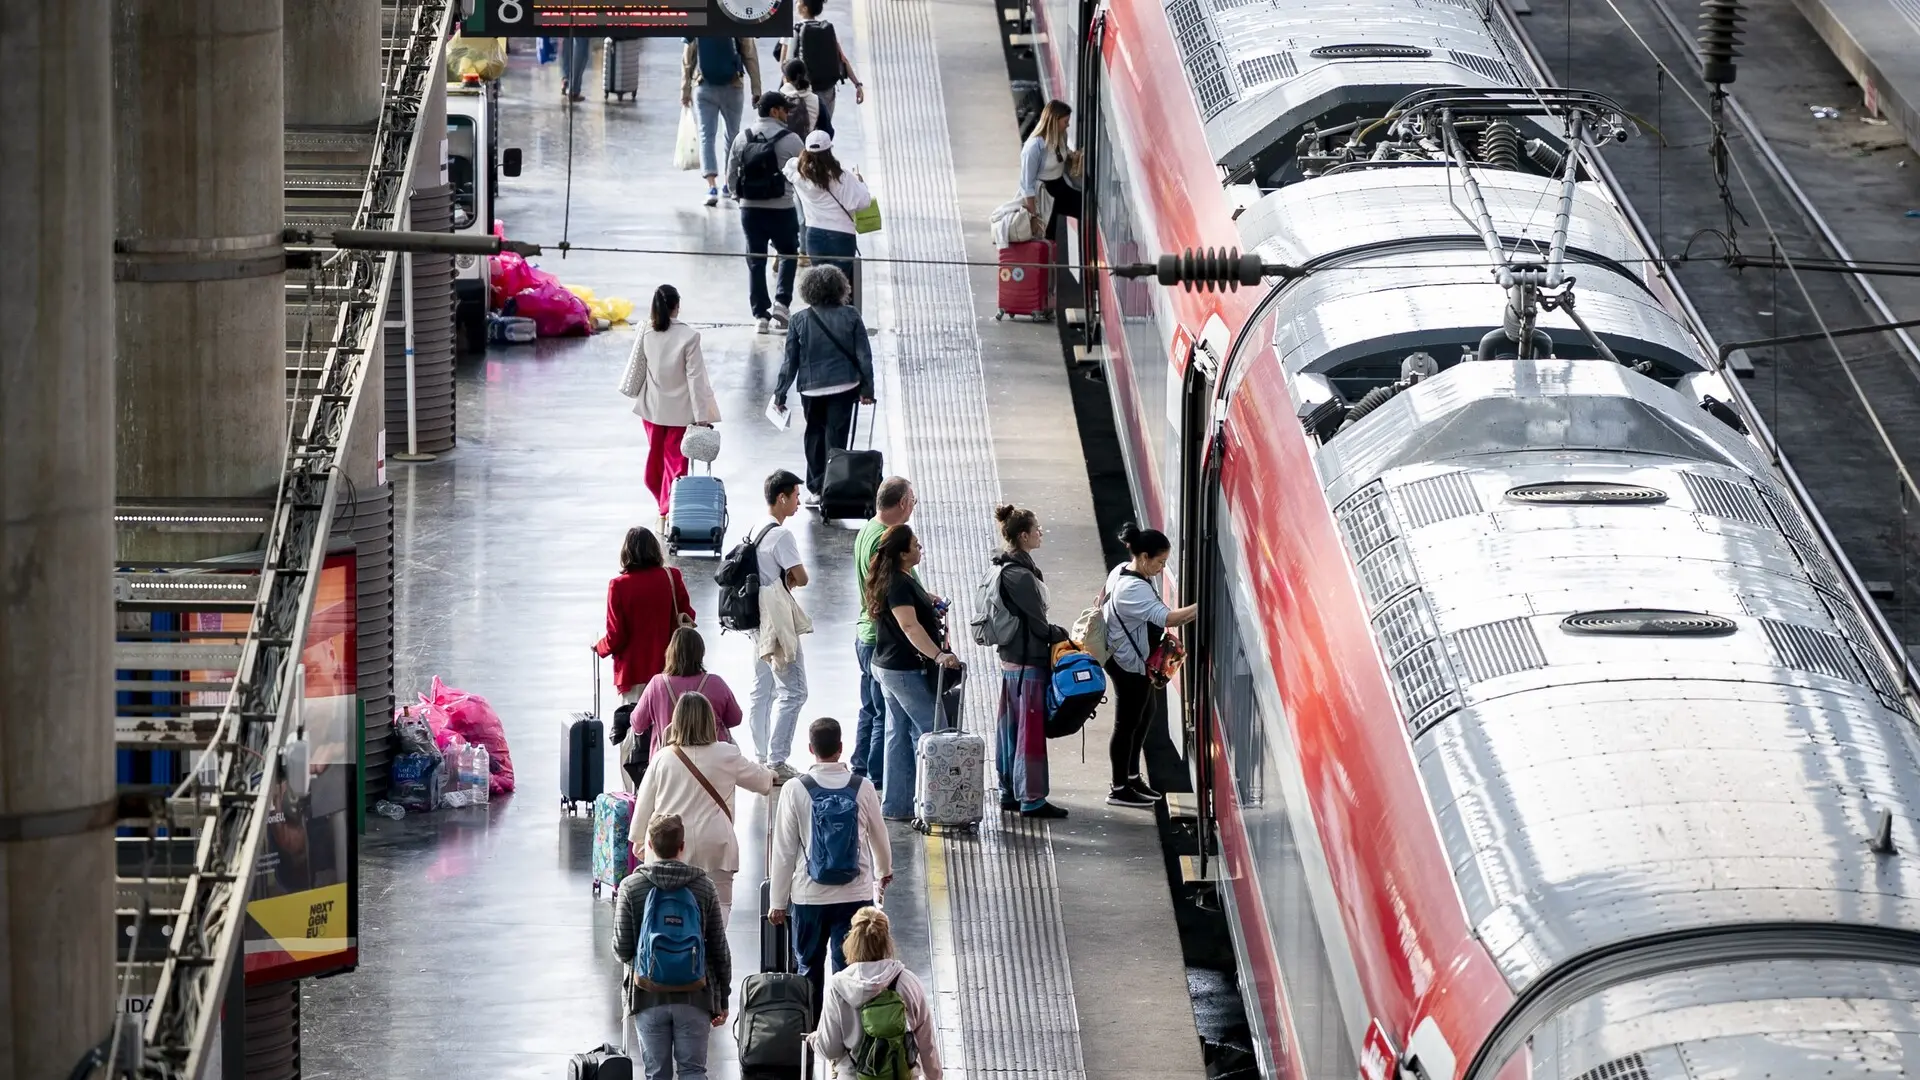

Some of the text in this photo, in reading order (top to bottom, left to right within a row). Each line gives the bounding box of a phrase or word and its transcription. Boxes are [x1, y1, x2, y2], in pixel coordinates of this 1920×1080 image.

[498, 0, 523, 23] 8
[745, 7, 753, 15] 6
[306, 926, 319, 939] EU
